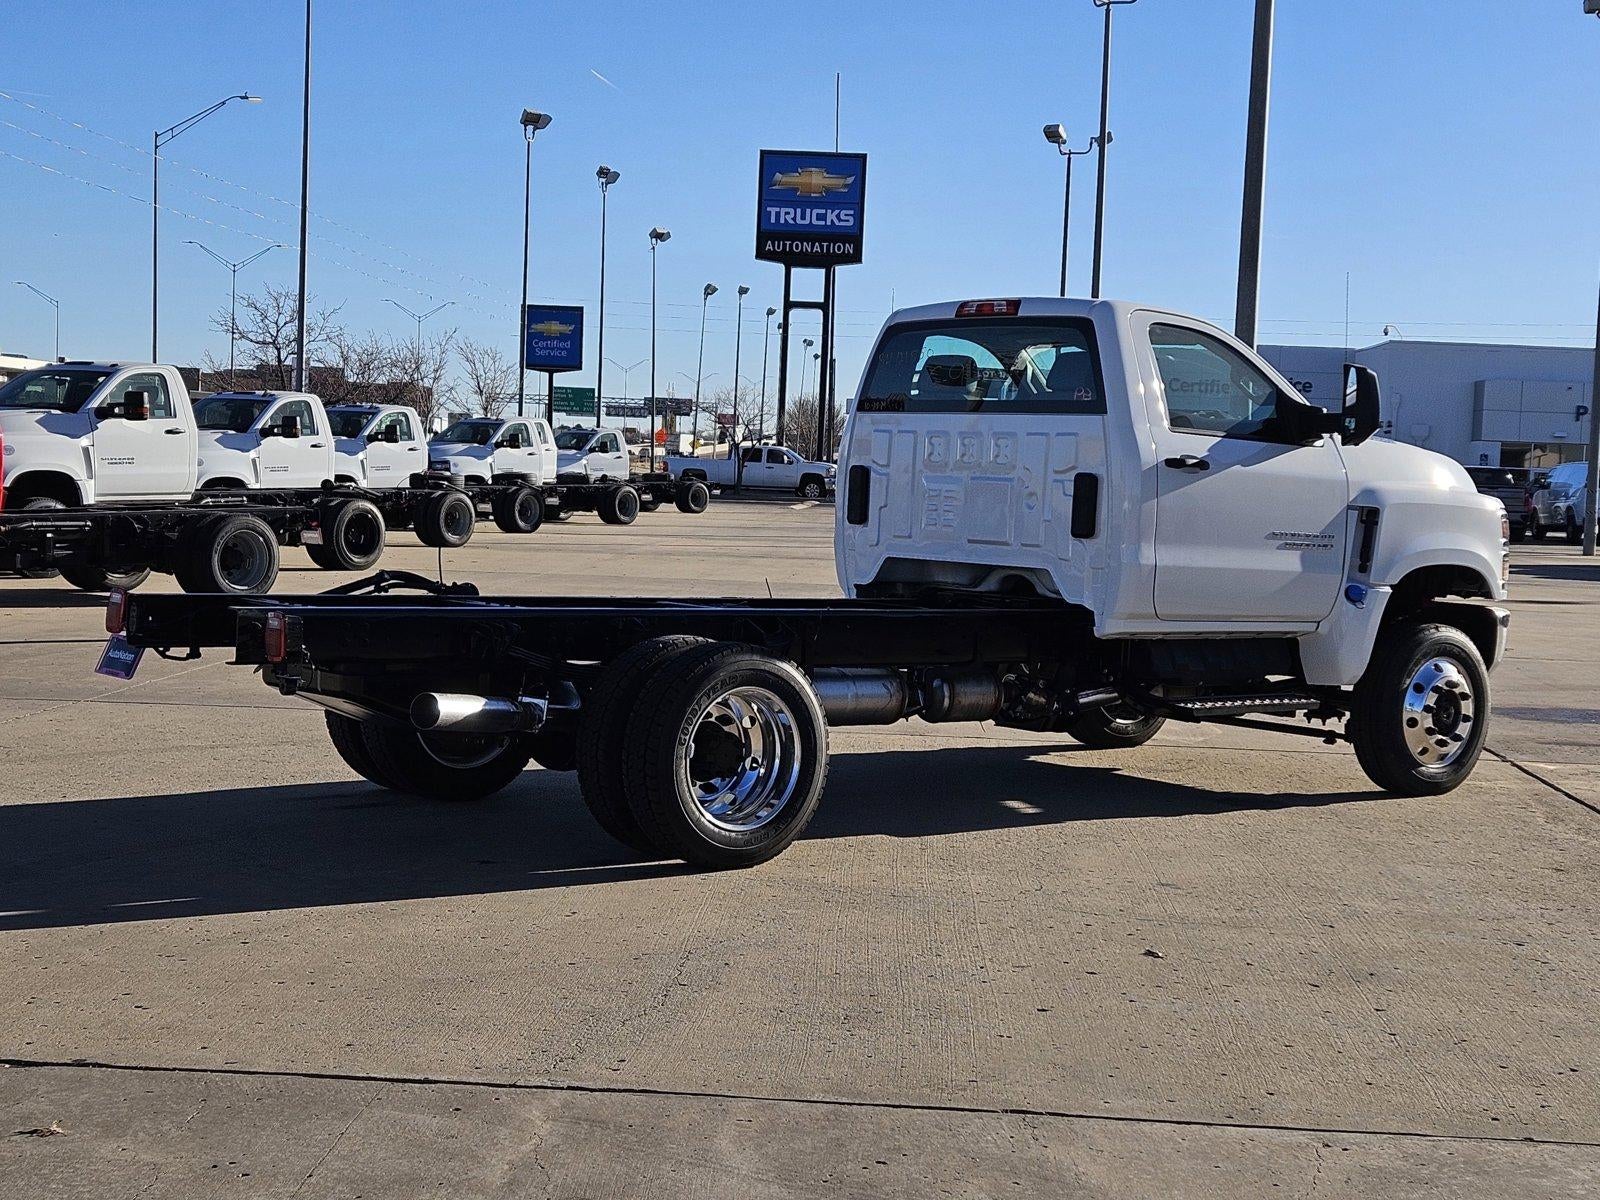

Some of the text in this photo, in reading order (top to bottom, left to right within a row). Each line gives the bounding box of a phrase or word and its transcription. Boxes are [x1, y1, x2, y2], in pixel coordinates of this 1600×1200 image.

[766, 206, 855, 227] TRUCKS
[765, 240, 854, 254] AUTONATION
[532, 339, 571, 349] Certified
[535, 348, 568, 357] Service
[1168, 377, 1231, 394] Certifie
